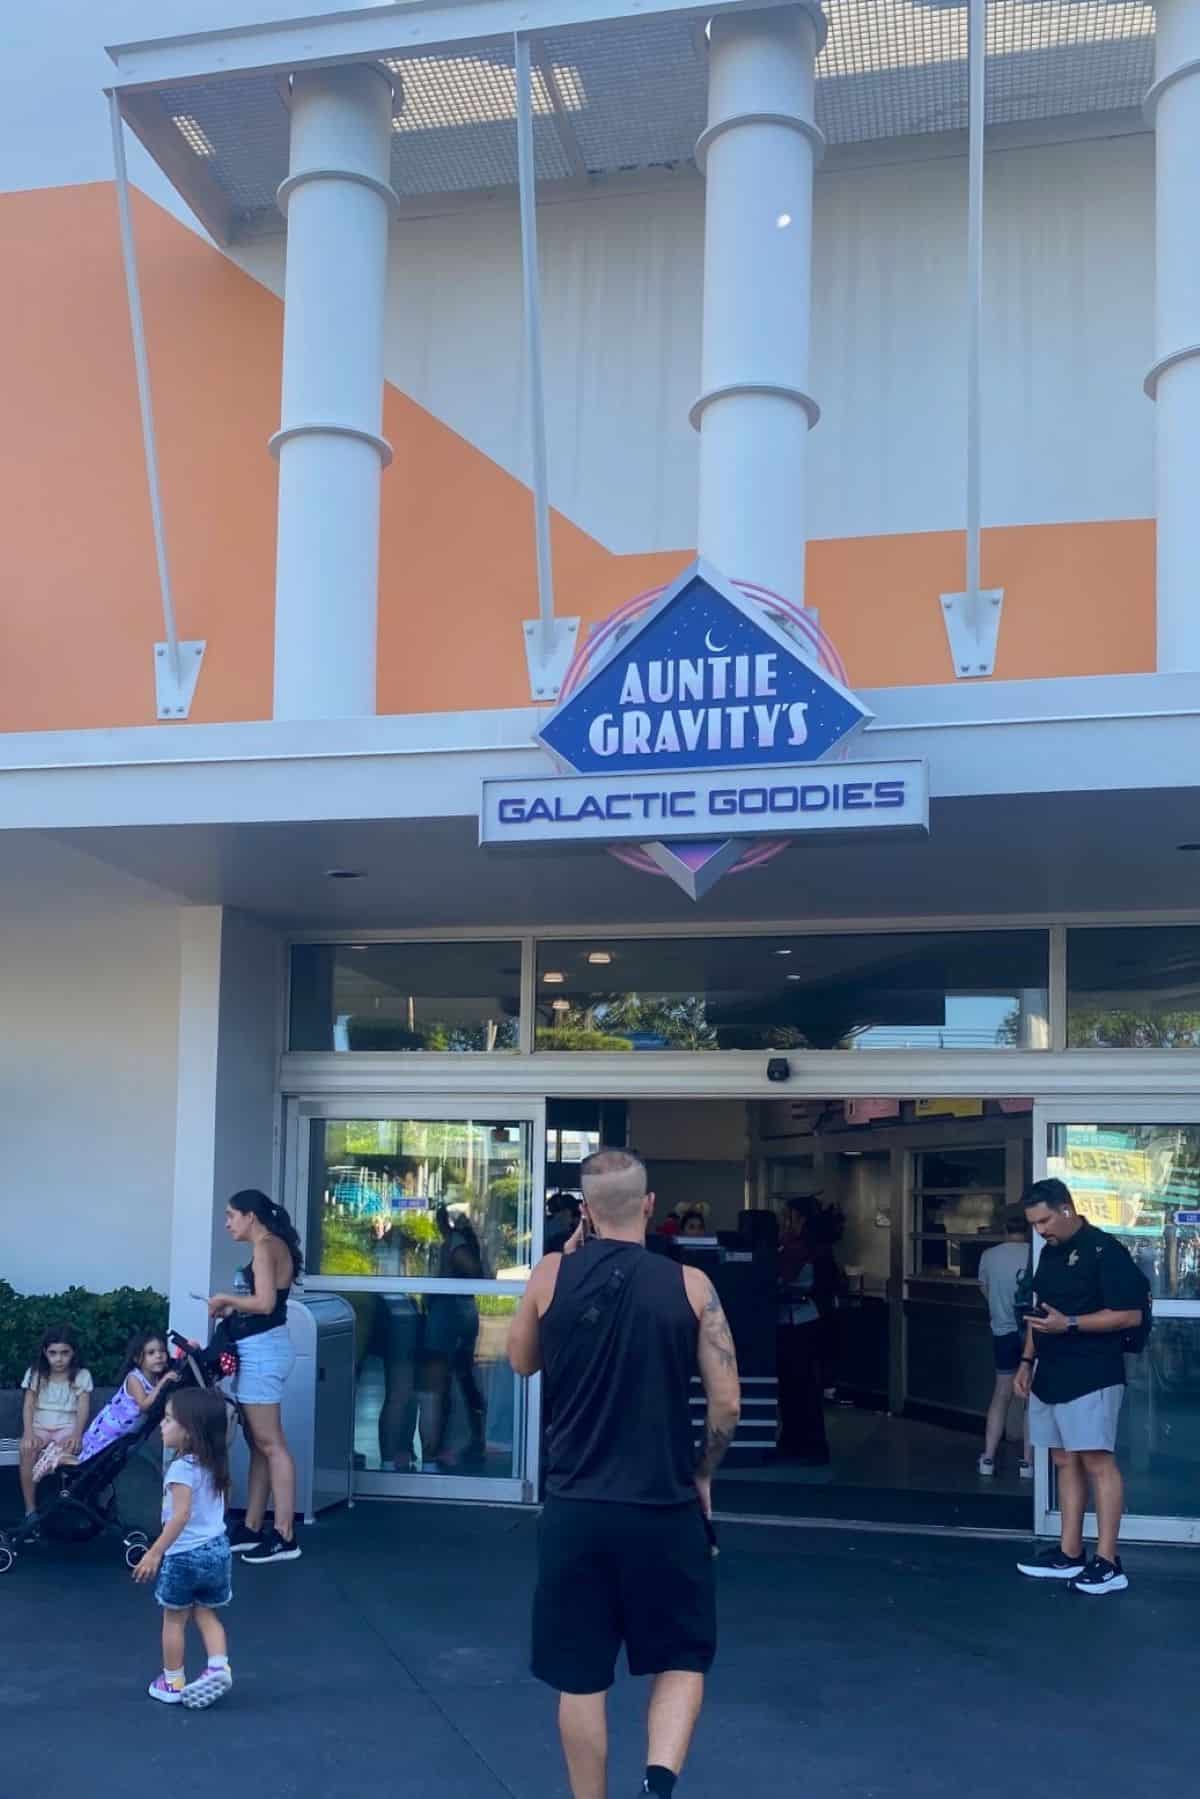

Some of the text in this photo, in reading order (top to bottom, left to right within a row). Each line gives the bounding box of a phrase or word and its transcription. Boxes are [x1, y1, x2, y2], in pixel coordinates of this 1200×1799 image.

[619, 653, 778, 704] AUNTIE
[589, 702, 808, 757] GRAVITY'S
[498, 781, 905, 824] GALACTIC GOODIES
